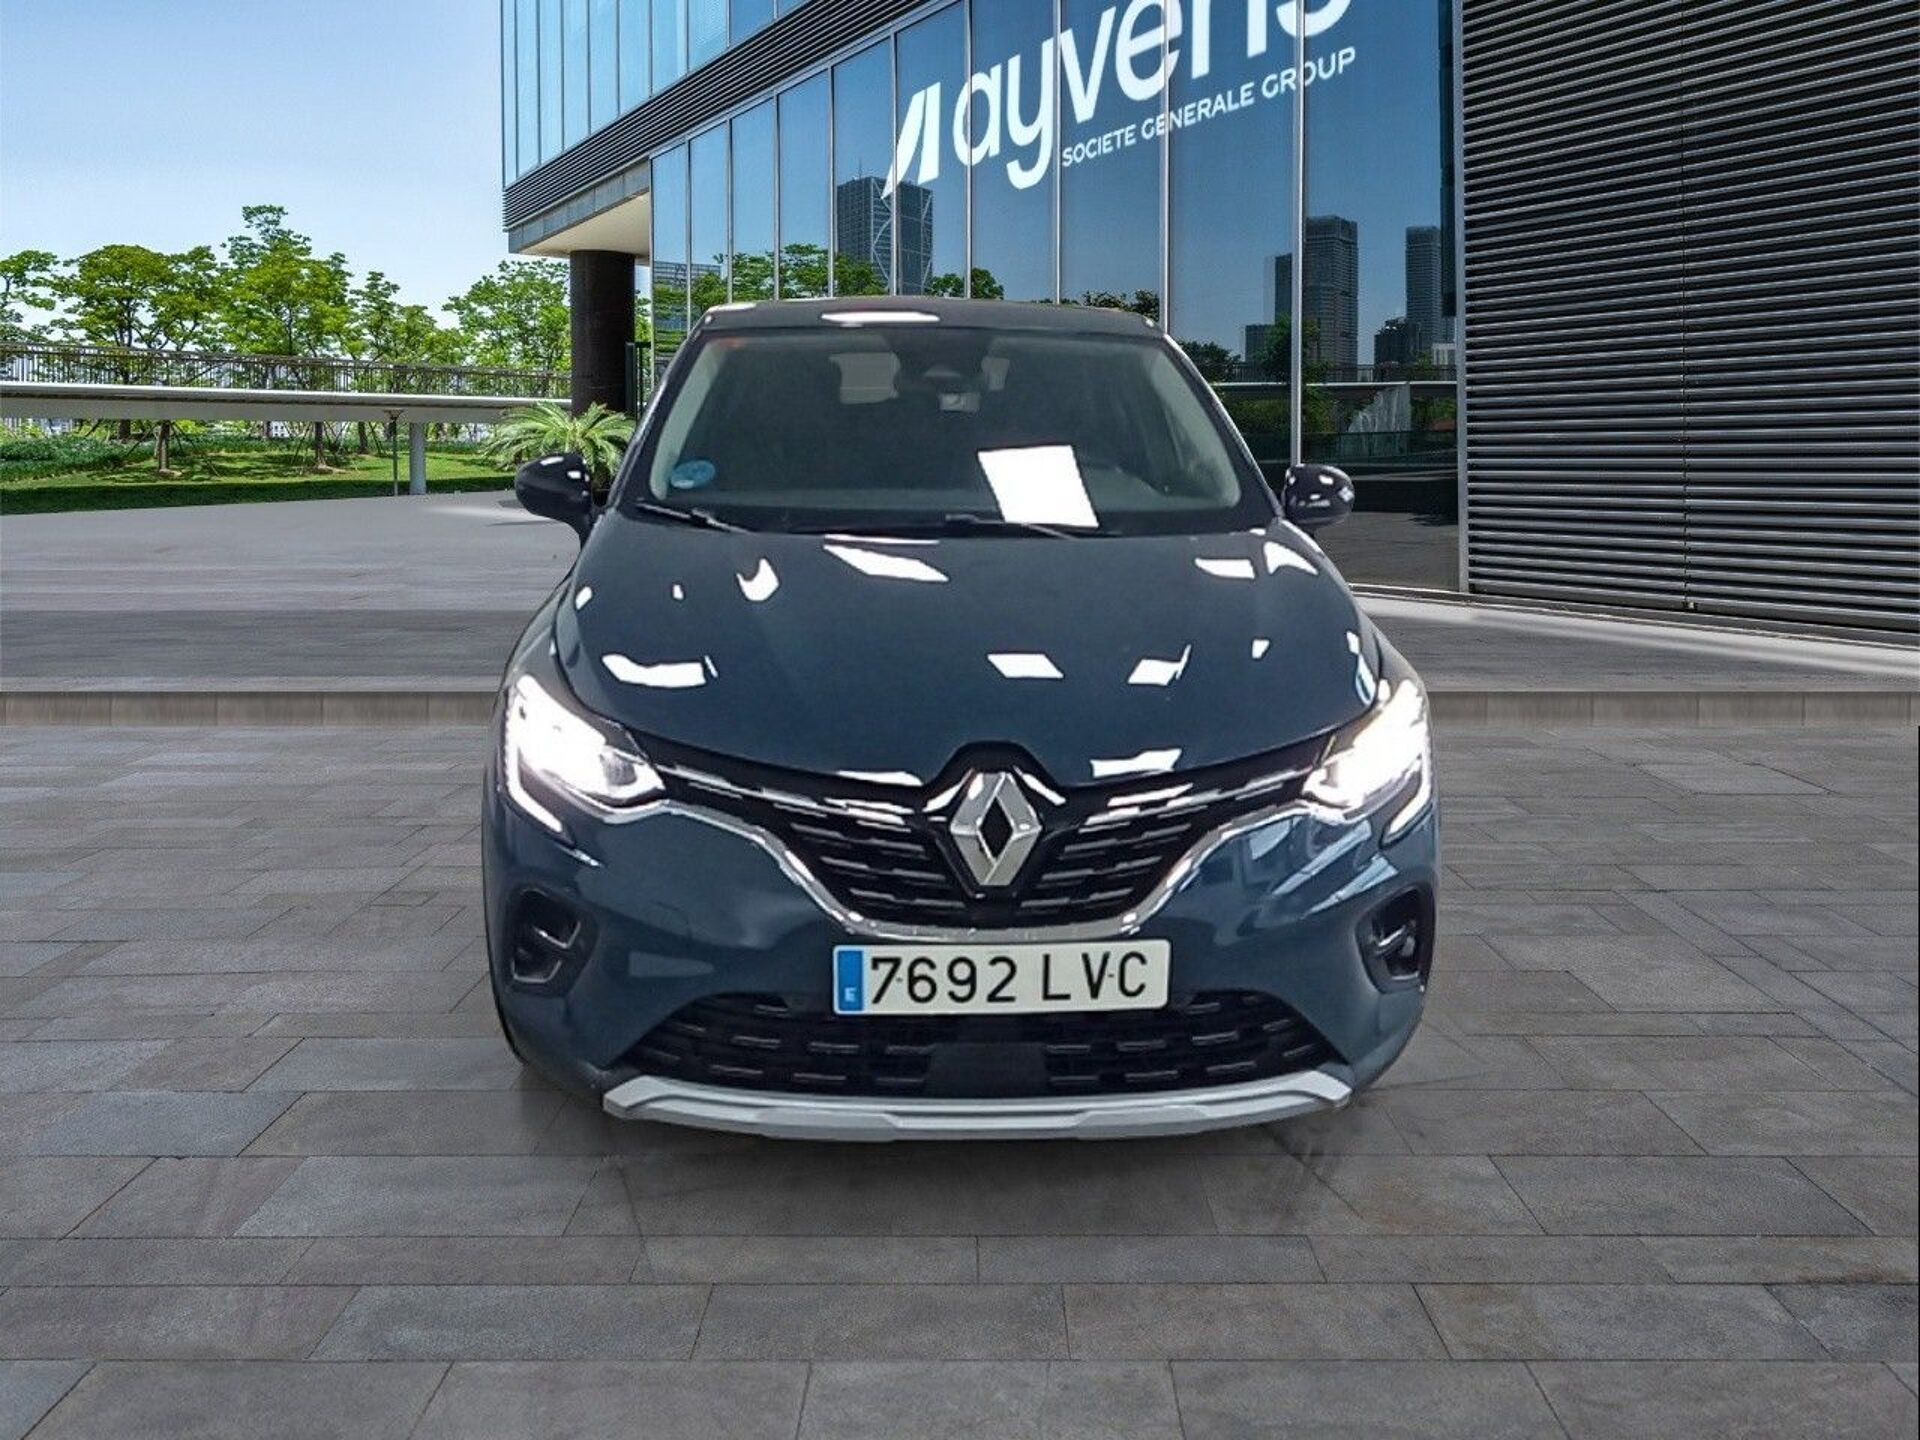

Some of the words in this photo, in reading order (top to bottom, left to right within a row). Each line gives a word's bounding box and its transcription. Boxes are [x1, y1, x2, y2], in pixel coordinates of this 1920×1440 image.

[952, 0, 1352, 190] ayven
[1062, 123, 1137, 168] SOCIETE
[1141, 82, 1255, 140] GENERALE
[1261, 46, 1356, 99] GROUP
[844, 987, 857, 1002] E
[871, 956, 1017, 1004] 7692
[1042, 951, 1147, 1001] LVC
